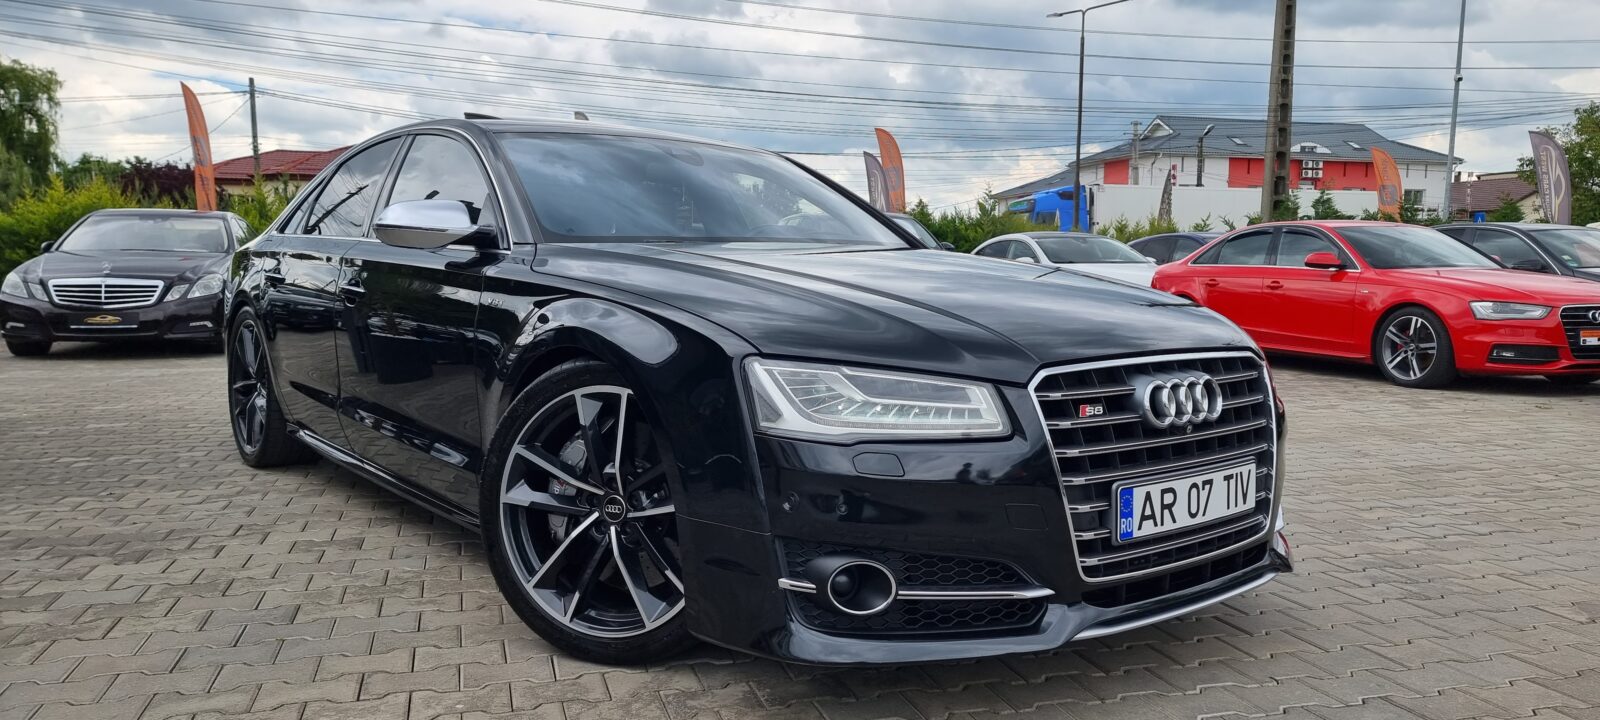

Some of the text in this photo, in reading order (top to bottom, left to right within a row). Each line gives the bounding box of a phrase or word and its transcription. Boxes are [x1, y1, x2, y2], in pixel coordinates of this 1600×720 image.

[1085, 406, 1103, 416] S8
[1137, 469, 1252, 531] AR 07 TIV
[1120, 517, 1133, 534] RO
